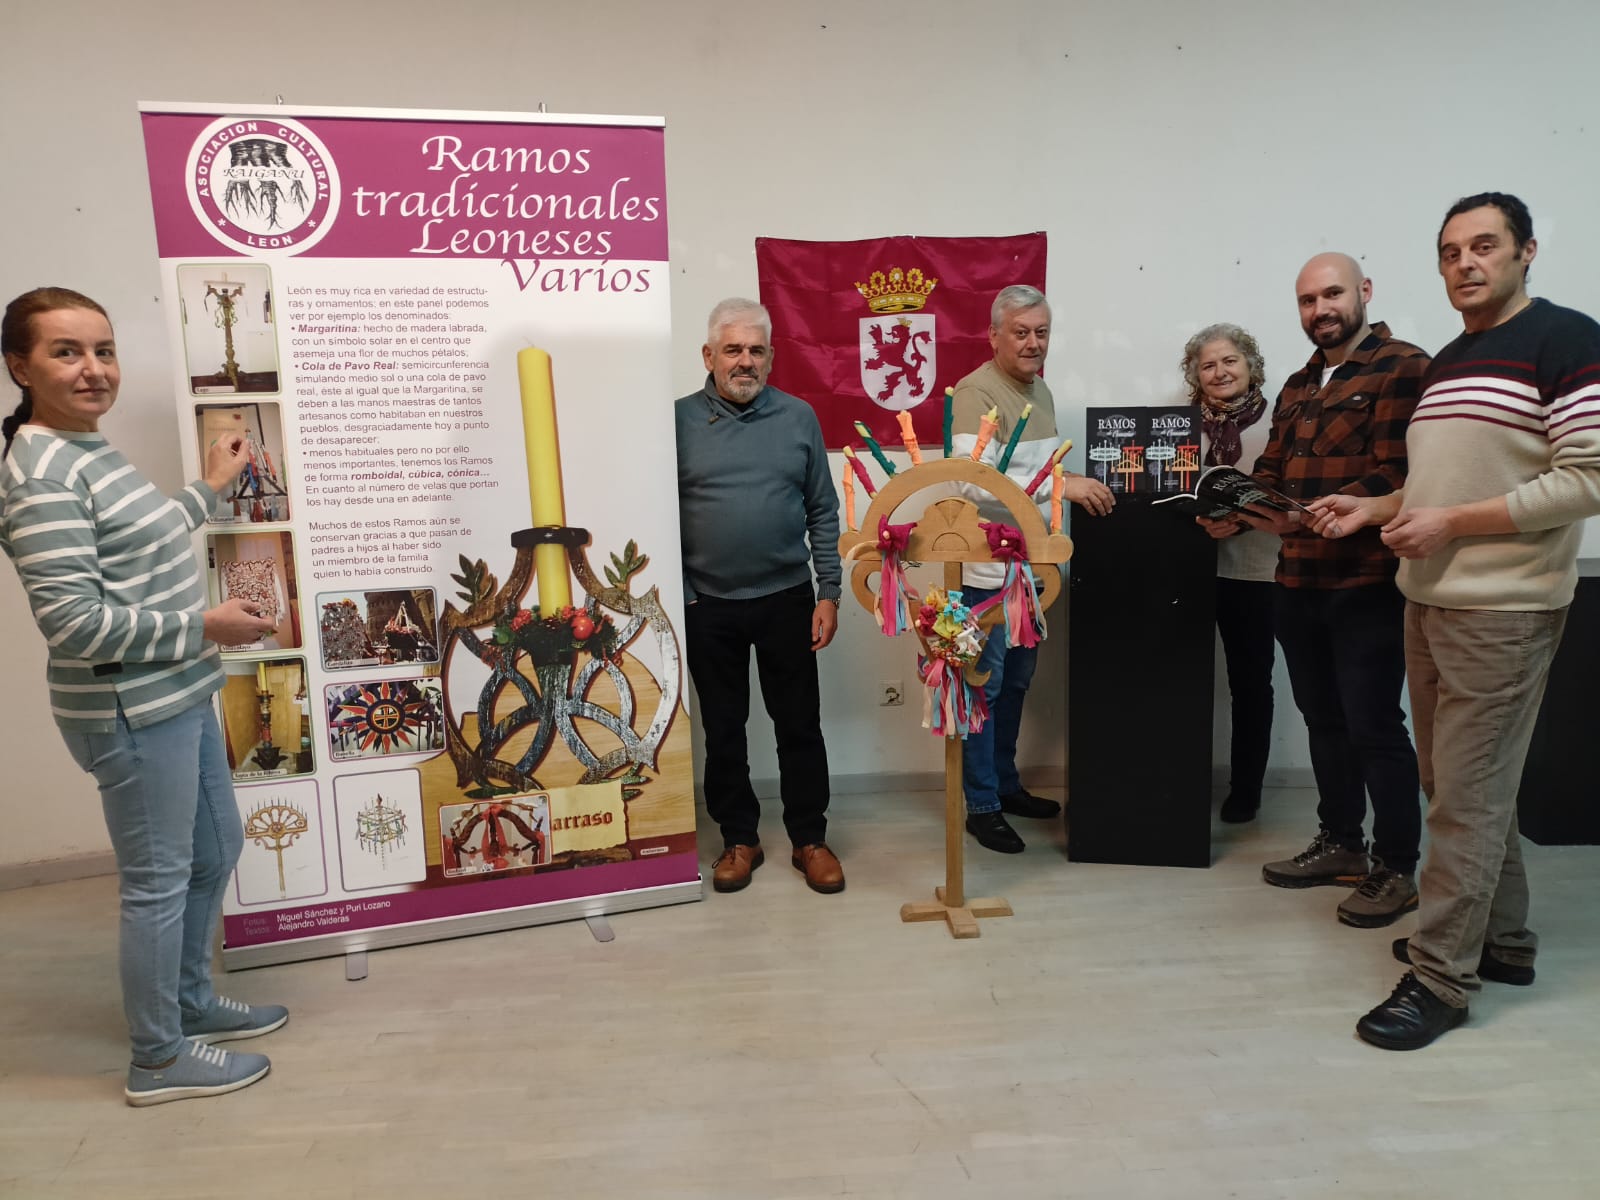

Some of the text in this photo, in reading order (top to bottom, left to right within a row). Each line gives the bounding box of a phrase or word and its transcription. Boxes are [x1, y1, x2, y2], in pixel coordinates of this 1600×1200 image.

[422, 135, 591, 174] Ramos
[198, 122, 329, 201] ASOCIACION CULTURAL
[352, 173, 659, 222] tradicionales
[247, 236, 294, 247] LEON
[410, 218, 612, 255] Leoneses
[501, 259, 651, 293] Varios
[287, 285, 313, 295] León
[330, 288, 351, 297] muy
[353, 285, 372, 295] rica
[389, 285, 430, 295] variedad
[432, 285, 445, 295] de
[447, 285, 488, 295] estructu-
[307, 301, 313, 311] y
[394, 298, 415, 308] este
[417, 298, 444, 310] panel
[446, 298, 489, 310] podemos
[290, 313, 305, 321] ver
[308, 313, 324, 323] por
[327, 311, 366, 323] ejemplo
[368, 311, 383, 320] los
[363, 323, 394, 333] hecho
[395, 323, 408, 333] de
[410, 323, 447, 333] madera
[292, 338, 310, 346] con
[313, 338, 326, 346] un
[369, 336, 393, 346] solar
[410, 336, 419, 345] el
[421, 335, 451, 345] centro
[453, 337, 471, 347] que
[293, 350, 335, 361] asemeja
[337, 350, 357, 358] una
[358, 348, 374, 358] flor
[376, 348, 390, 358] de
[391, 348, 430, 358] muchos
[301, 361, 326, 370] Cola
[328, 360, 342, 370] de
[344, 360, 371, 370] Pavo
[296, 372, 487, 384] simulando medio sol o una cola de pavo
[345, 385, 354, 395] al
[356, 385, 380, 397] igual
[382, 387, 400, 397] que
[402, 385, 411, 394] la
[472, 386, 483, 394] se
[297, 396, 482, 408] deben a las manos maestras de tantos
[299, 410, 348, 421] artesanos
[350, 412, 377, 420] como
[379, 409, 426, 419] habitaban
[443, 408, 484, 418] nuestros
[344, 421, 432, 434] desgraciadamente
[434, 420, 452, 433] hoy
[454, 422, 461, 430] a
[463, 420, 490, 432] punto
[1098, 418, 1136, 430] RAMOS
[1152, 417, 1191, 429] RAMOS
[301, 435, 314, 445] de
[309, 444, 470, 458] menos habituales pero no por ello
[304, 461, 337, 470] menos
[400, 456, 442, 467] tenemos
[444, 456, 458, 466] los
[460, 455, 493, 466] Ramos
[304, 472, 317, 482] de
[320, 471, 348, 482] forma
[408, 468, 444, 480] cúbica,
[306, 479, 499, 494] En cuanto al número de velas que portan
[306, 496, 321, 507] los
[324, 496, 342, 508] hay
[344, 495, 374, 505] desde
[376, 496, 395, 504] una
[397, 496, 409, 504] en
[309, 516, 461, 531] Muchos de estos Ramos aún se
[310, 533, 361, 543] conservan
[363, 530, 398, 543] gracias
[409, 531, 427, 541] que
[429, 529, 458, 540] pasan
[460, 527, 472, 537] de
[312, 539, 442, 557] padres a hijos al haber sido
[312, 559, 325, 567] un
[328, 555, 370, 566] miembro
[372, 554, 385, 564] de
[387, 554, 396, 564] la
[313, 568, 341, 582] quien
[343, 568, 352, 578] lo
[276, 911, 303, 923] Miguel
[305, 908, 337, 920] Sánchez
[339, 908, 344, 916] y
[346, 904, 362, 912] Puri
[363, 901, 391, 910] Lozano
[278, 919, 314, 932] Alejandro
[317, 915, 350, 926] Valderas
